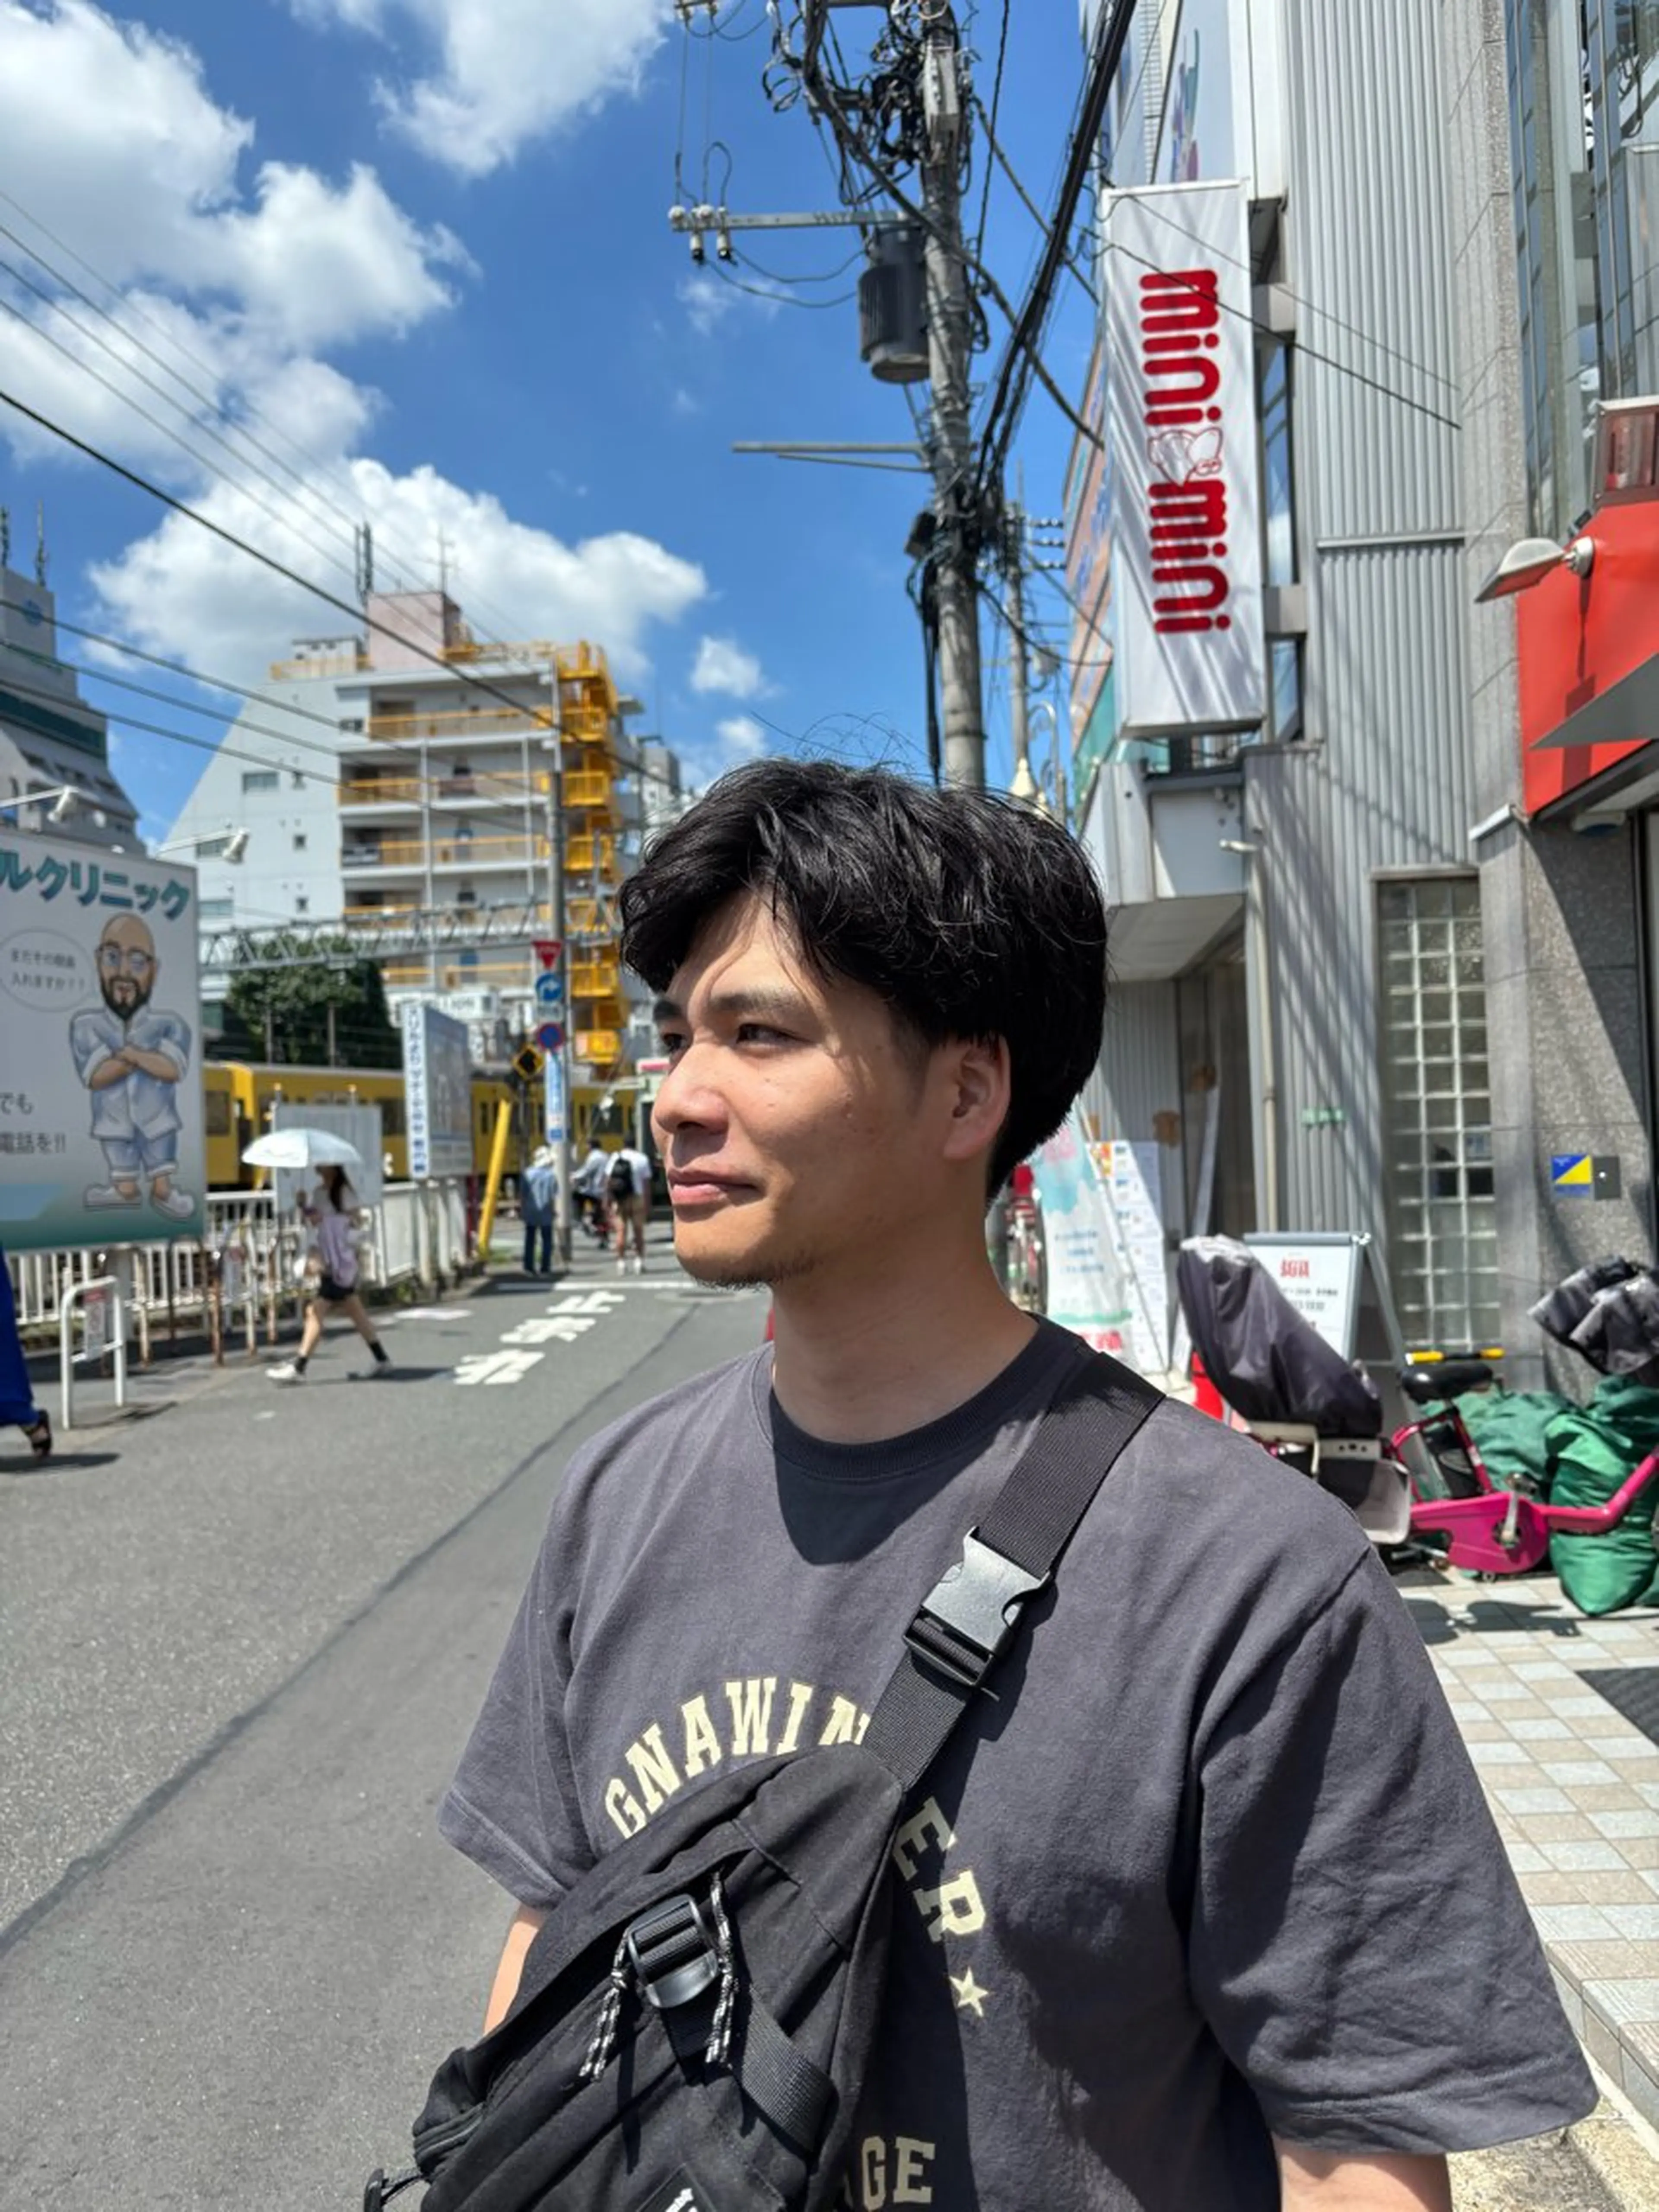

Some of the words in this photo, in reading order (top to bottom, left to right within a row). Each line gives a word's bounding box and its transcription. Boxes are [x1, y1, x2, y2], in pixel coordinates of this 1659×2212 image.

[1139, 269, 1221, 426] mini
[1147, 479, 1231, 634] mini
[0, 851, 190, 920] ルクリニック
[845, 2136, 935, 2212] GE
